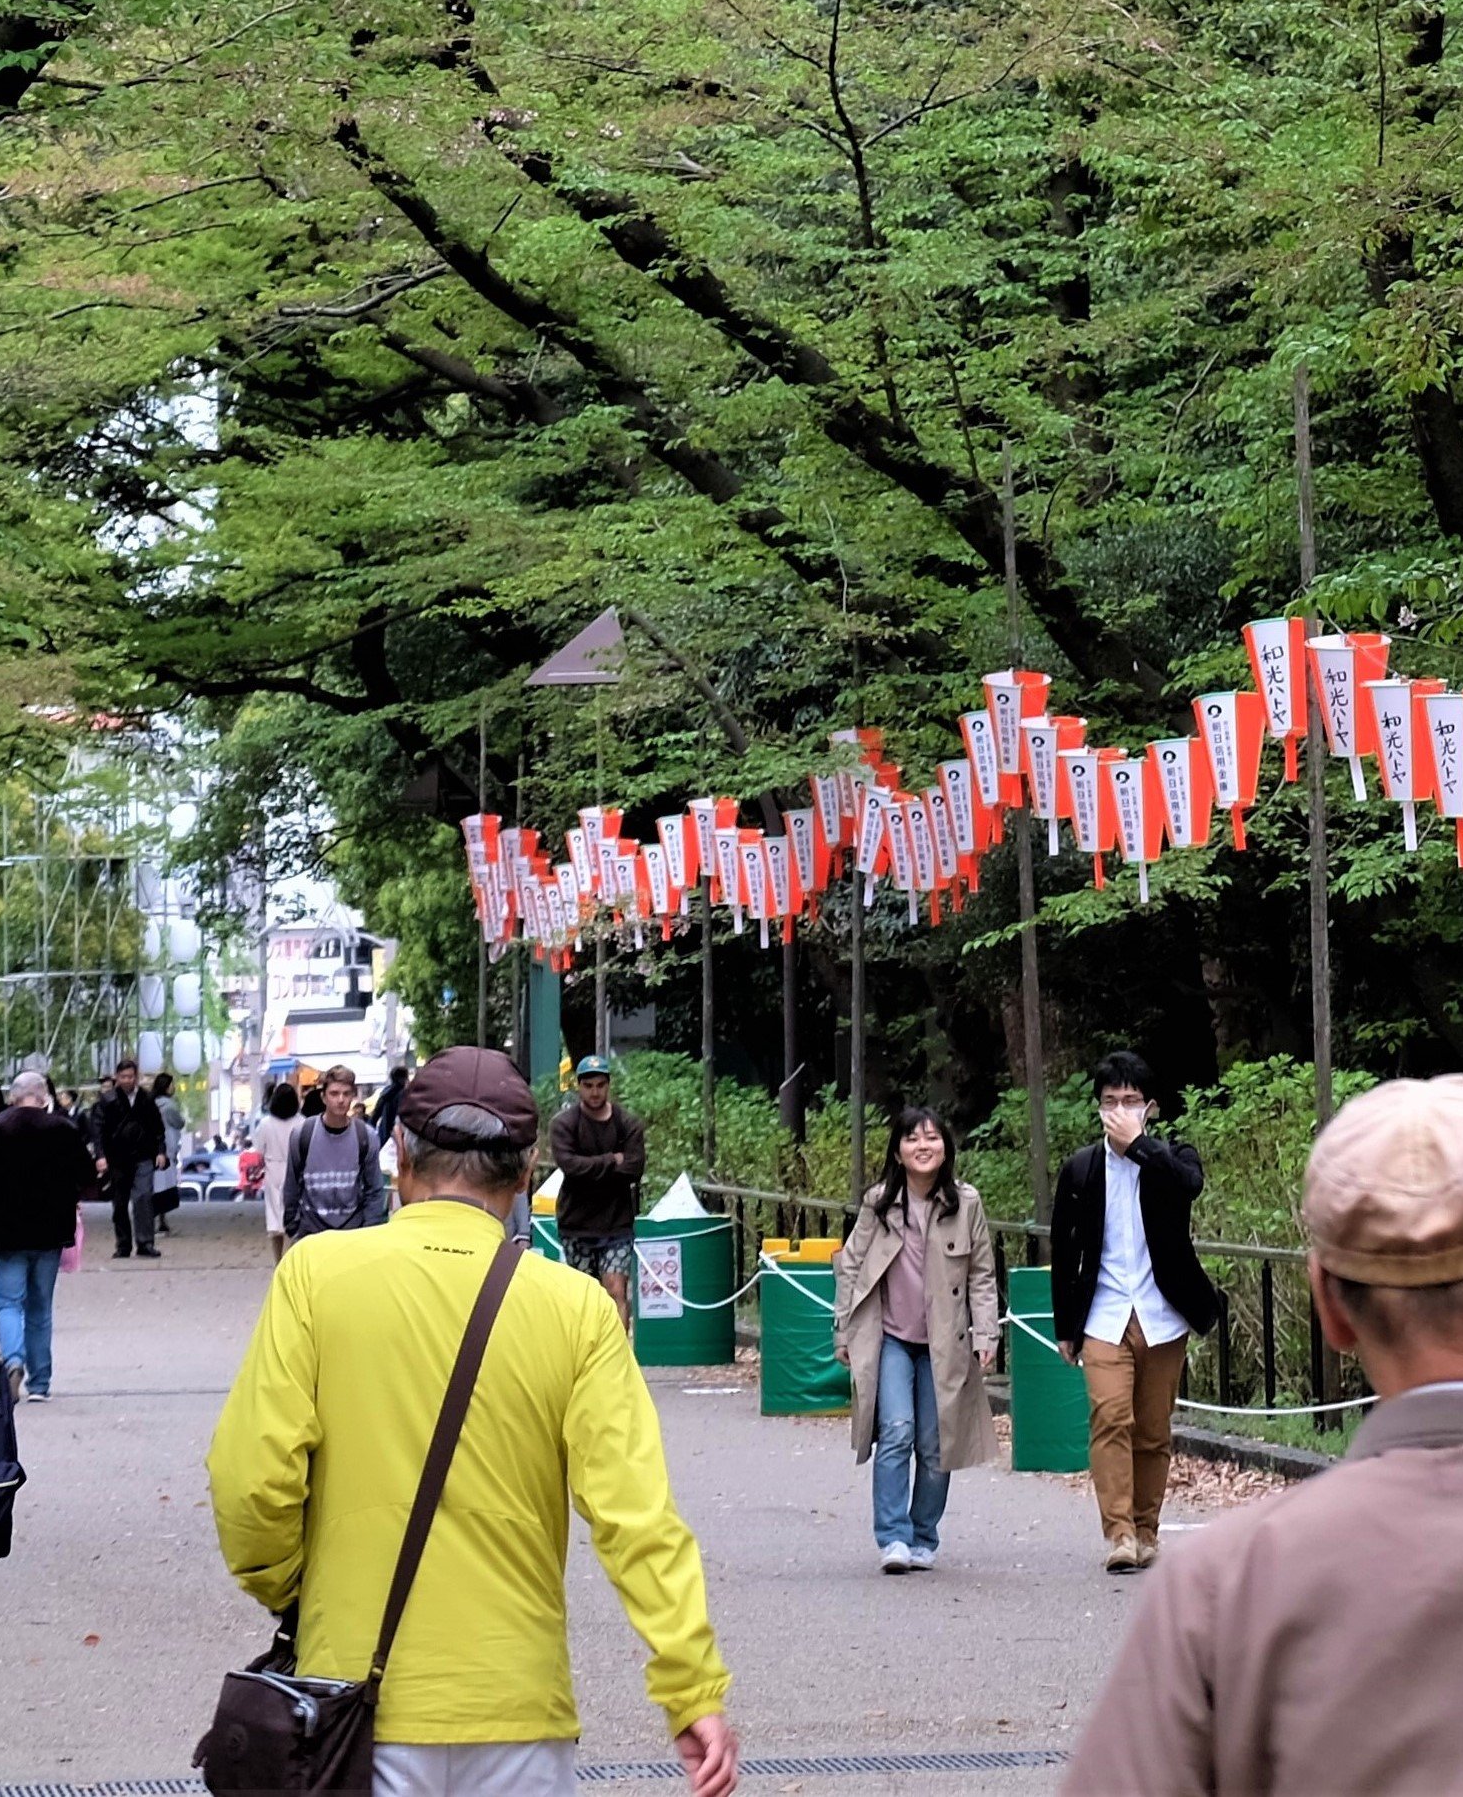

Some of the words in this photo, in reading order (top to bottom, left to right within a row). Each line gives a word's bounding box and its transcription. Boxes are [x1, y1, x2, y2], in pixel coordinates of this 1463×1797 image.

[1260, 644, 1288, 725] 和光ハトヤ
[1324, 668, 1350, 748] 和光ハトヤ
[1381, 711, 1407, 784] 和光ハトヤ
[1435, 720, 1457, 794] 和光ハトヤ
